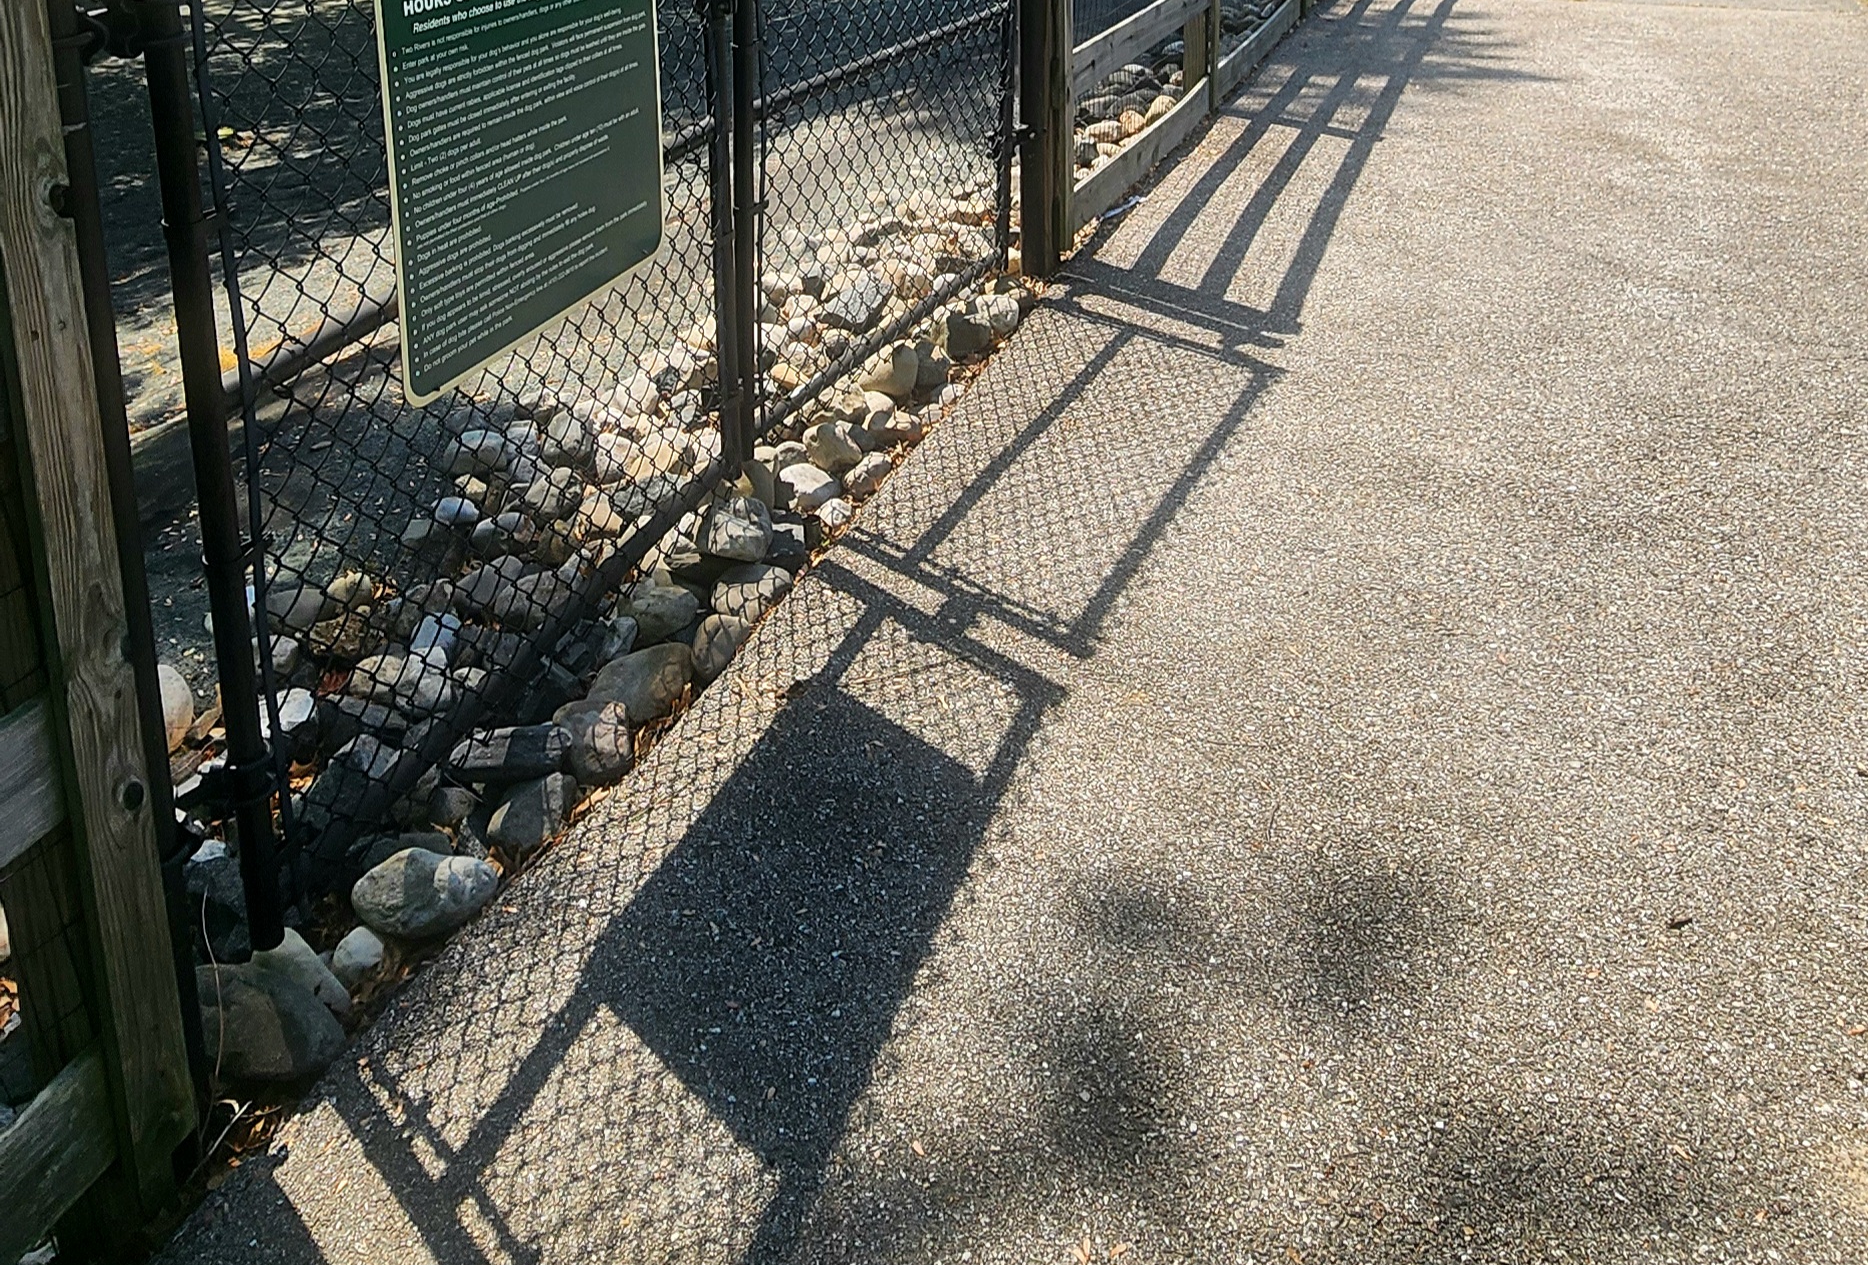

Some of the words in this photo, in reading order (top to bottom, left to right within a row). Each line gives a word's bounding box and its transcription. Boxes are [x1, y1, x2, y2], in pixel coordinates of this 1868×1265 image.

[413, 13, 451, 34] Residents
[452, 9, 468, 23] who
[468, 2, 494, 18] choose
[495, 0, 502, 10] to
